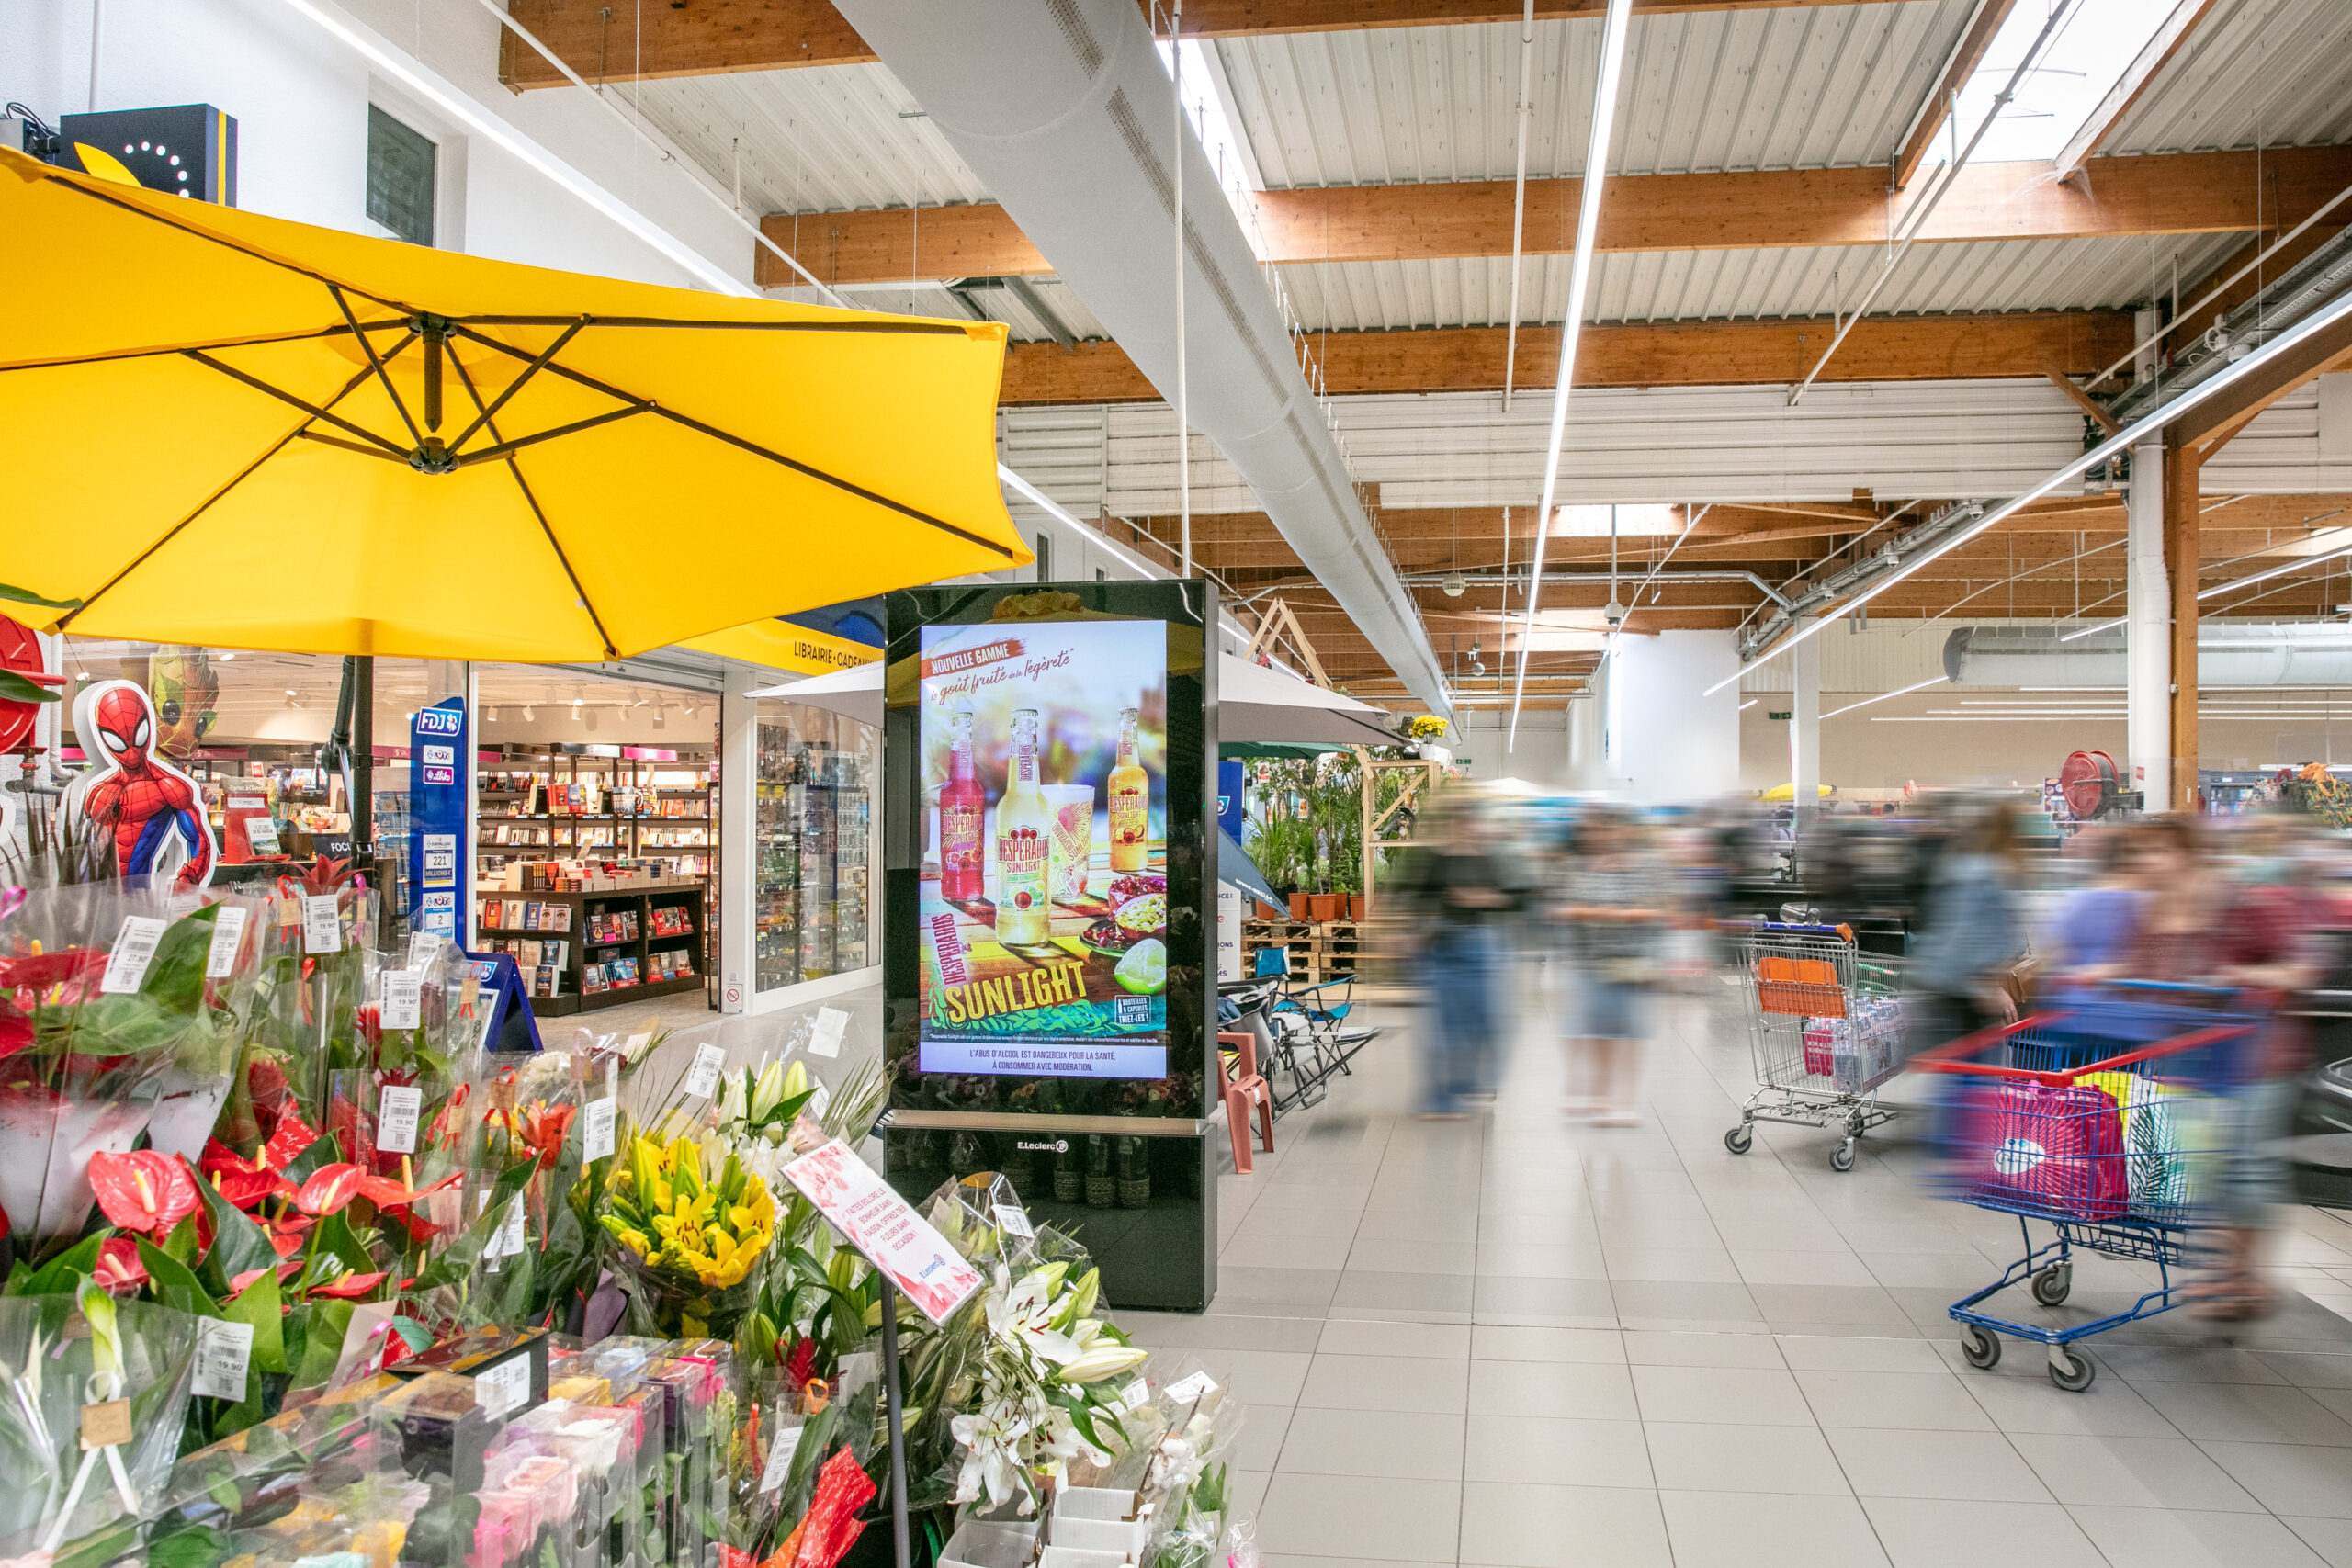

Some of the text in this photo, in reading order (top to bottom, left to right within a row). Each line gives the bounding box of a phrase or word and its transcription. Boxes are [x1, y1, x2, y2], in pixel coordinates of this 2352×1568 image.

[794, 640, 873, 669] LIBRAIRIE CADEA
[931, 643, 1010, 675] NOUVELLE GAMME
[939, 674, 971, 705] goût
[970, 666, 1007, 694] fruité
[421, 712, 446, 730] FDJ
[1111, 794, 1148, 811] DESPERADO
[944, 814, 984, 833] DESPERADO
[998, 838, 1050, 862] DESPERADOS
[433, 855, 447, 866] 221
[1006, 860, 1041, 874] SUNLIGHT
[438, 915, 443, 925] 2
[931, 912, 967, 986] DESPERADOS
[944, 961, 1087, 1023] SUNLIGHT
[1127, 1004, 1148, 1012] CAPSULES
[1118, 1013, 1145, 1024] TRIEZ-LES
[969, 1049, 990, 1058] L'ABUS
[991, 1050, 1019, 1059] D'ALCOOL
[1021, 1050, 1031, 1059] EST
[1033, 1050, 1067, 1059] DANGEREUX
[1069, 1051, 1084, 1060] POUR
[1086, 1052, 1093, 1060] LA
[998, 1062, 1035, 1070] CONSOMMER
[1036, 1062, 1052, 1070] AVEC
[1017, 1142, 1056, 1150] E.Leclerc
[878, 1199, 893, 1211] SANS
[895, 1204, 908, 1214] DES
[880, 1219, 910, 1242] FLEURS SANS
